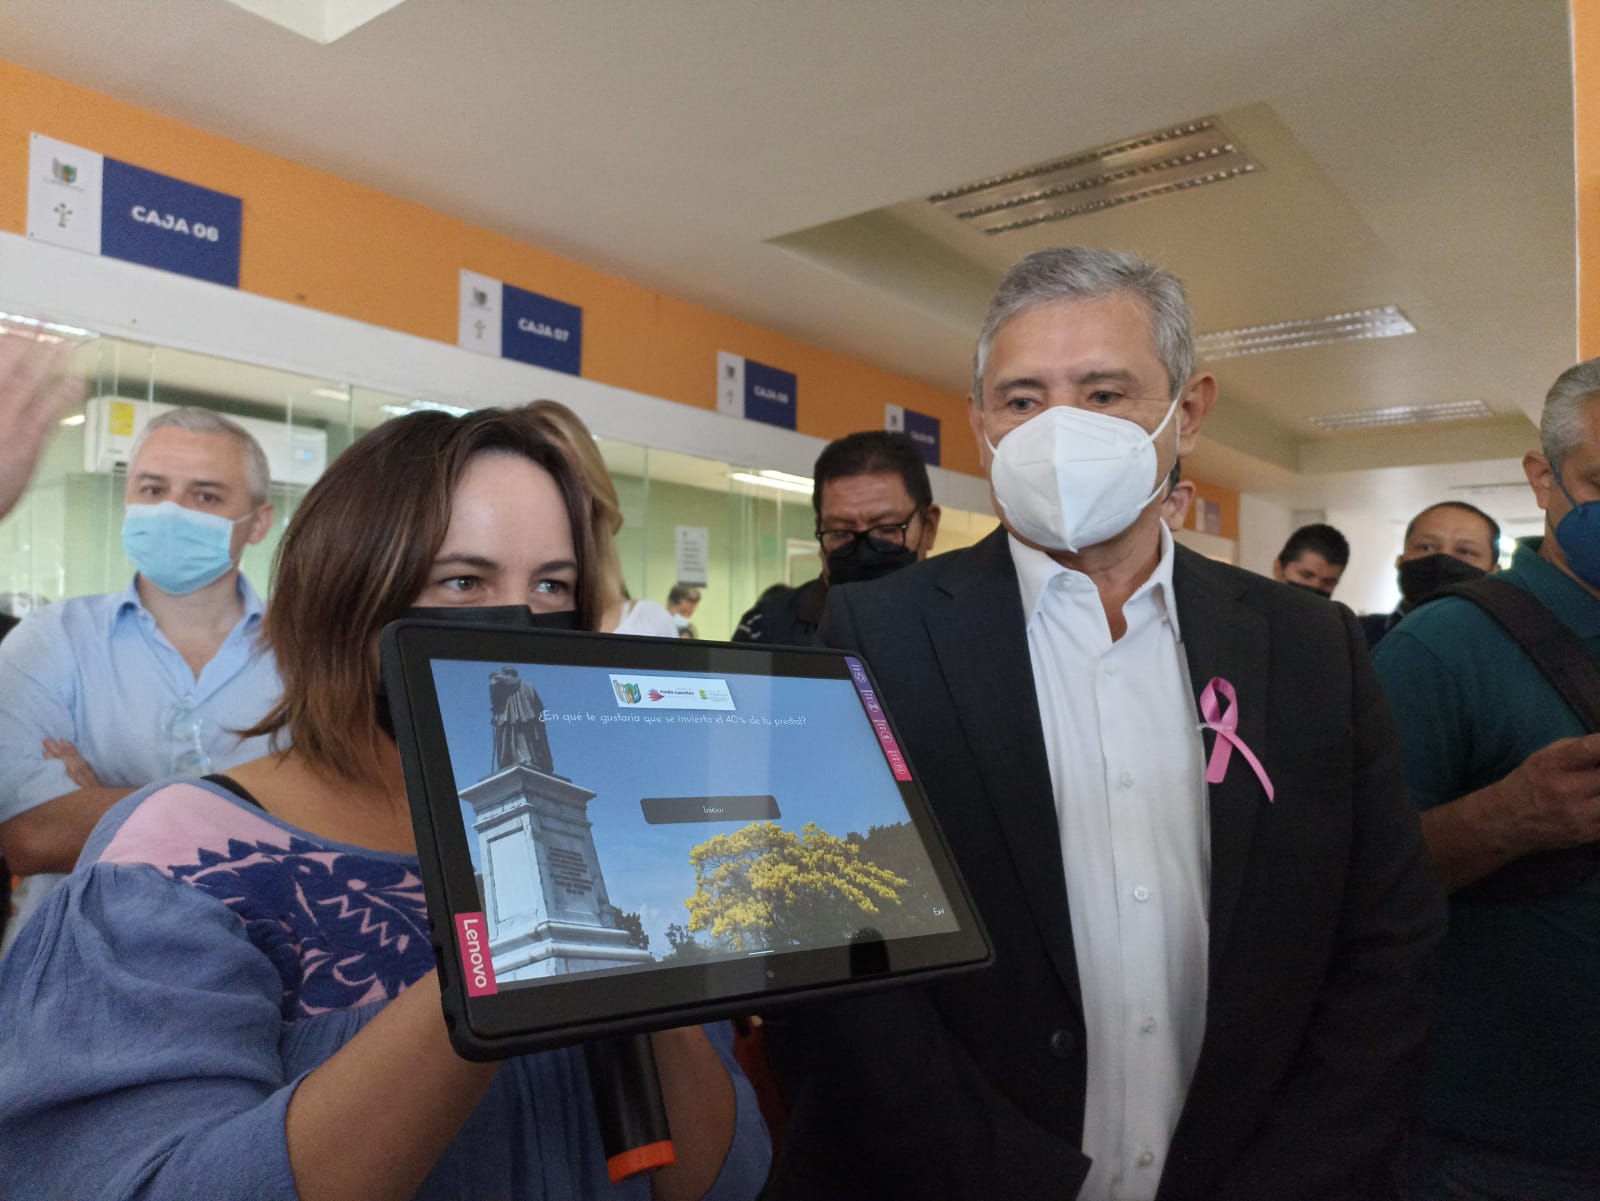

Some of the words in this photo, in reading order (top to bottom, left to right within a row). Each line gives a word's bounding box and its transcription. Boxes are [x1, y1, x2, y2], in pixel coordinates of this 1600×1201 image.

[131, 205, 190, 235] CAJA
[517, 317, 553, 337] CAJA
[562, 711, 583, 724] qué
[586, 711, 597, 721] te
[643, 714, 662, 725] que
[665, 715, 675, 723] se
[749, 714, 760, 725] de
[463, 918, 487, 989] Lenovo
